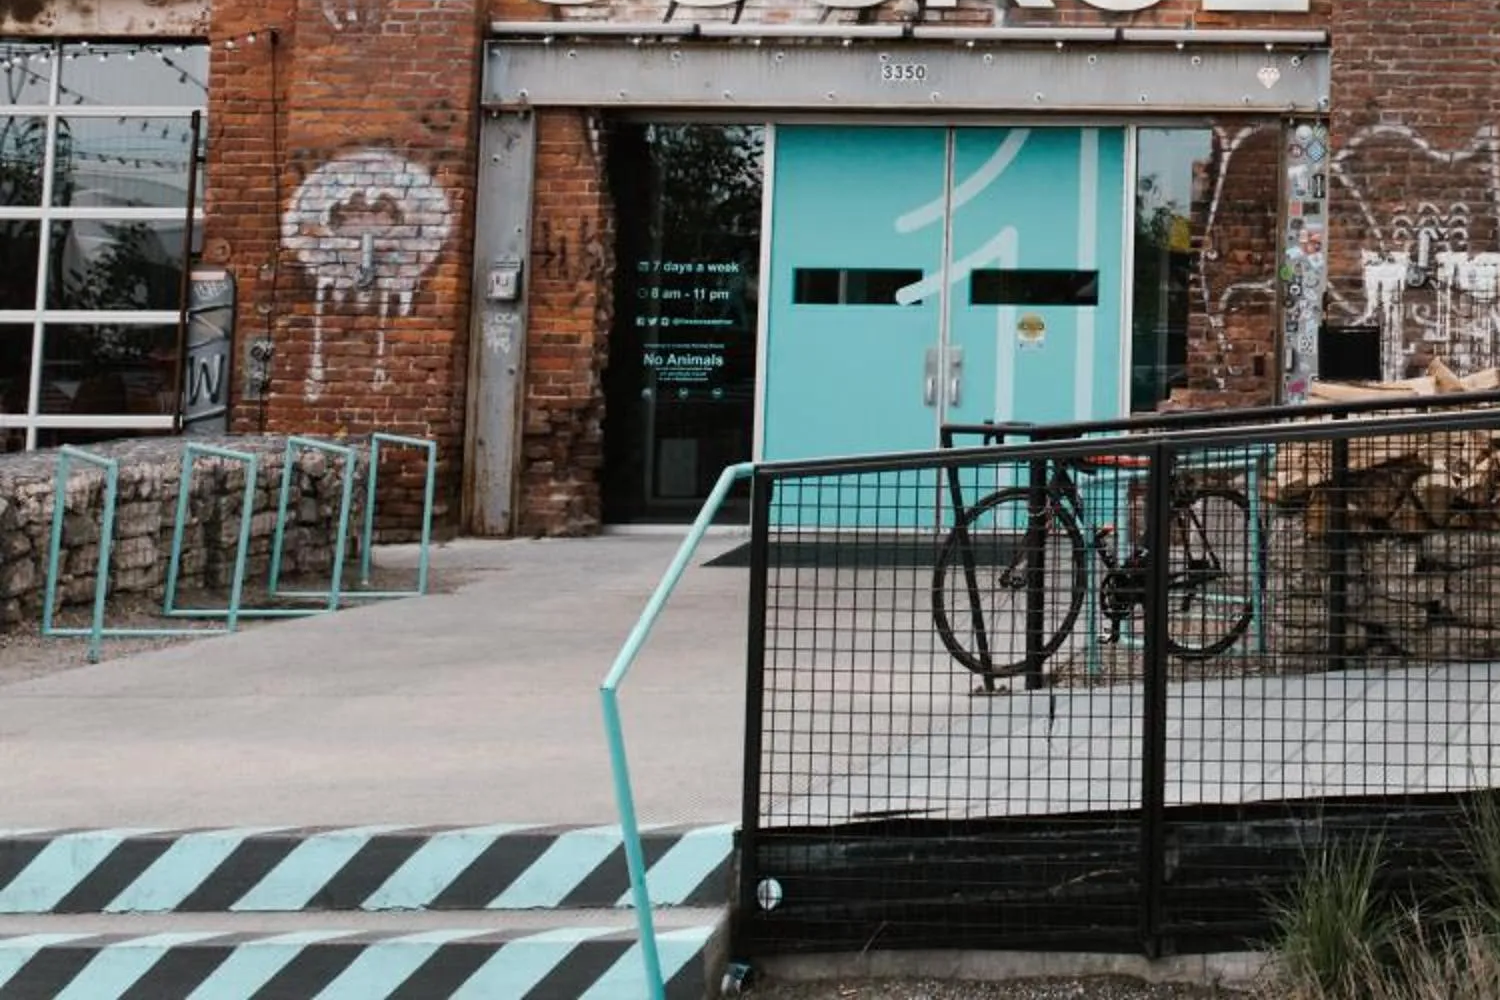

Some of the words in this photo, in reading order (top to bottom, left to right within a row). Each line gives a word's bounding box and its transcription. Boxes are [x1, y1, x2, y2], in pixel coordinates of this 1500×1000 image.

[883, 64, 926, 80] 3350
[653, 261, 661, 272] 7
[663, 261, 693, 274] days
[695, 263, 705, 272] a
[707, 261, 740, 273] week
[662, 289, 681, 299] am
[693, 288, 706, 299] 11
[709, 290, 729, 302] pm
[643, 353, 663, 366] No
[666, 353, 724, 367] Animals
